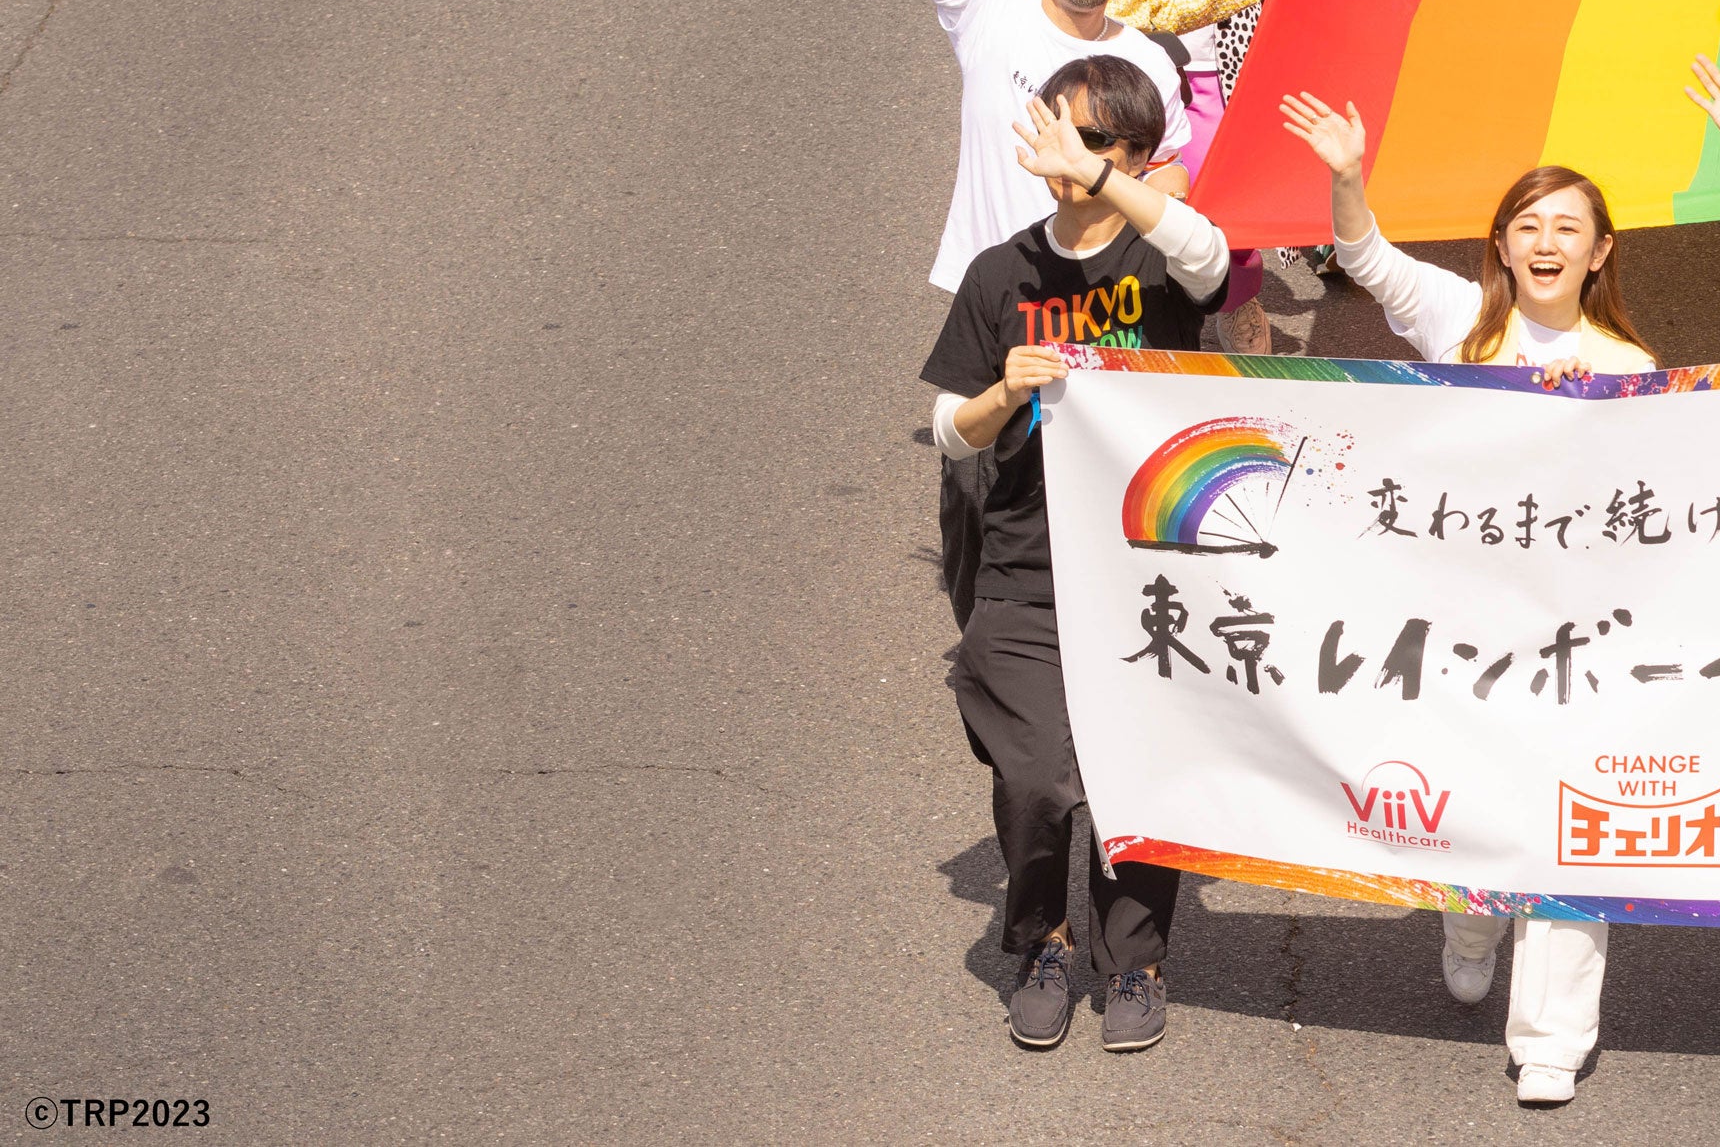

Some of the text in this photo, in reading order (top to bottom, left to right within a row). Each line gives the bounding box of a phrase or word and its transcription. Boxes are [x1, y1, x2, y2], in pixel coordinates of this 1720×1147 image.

[1017, 275, 1143, 346] TOKYO
[1594, 755, 1701, 774] CHANGE
[1617, 780, 1677, 797] WITH
[1340, 781, 1451, 834] ViiV
[1347, 820, 1451, 850] Healthcare
